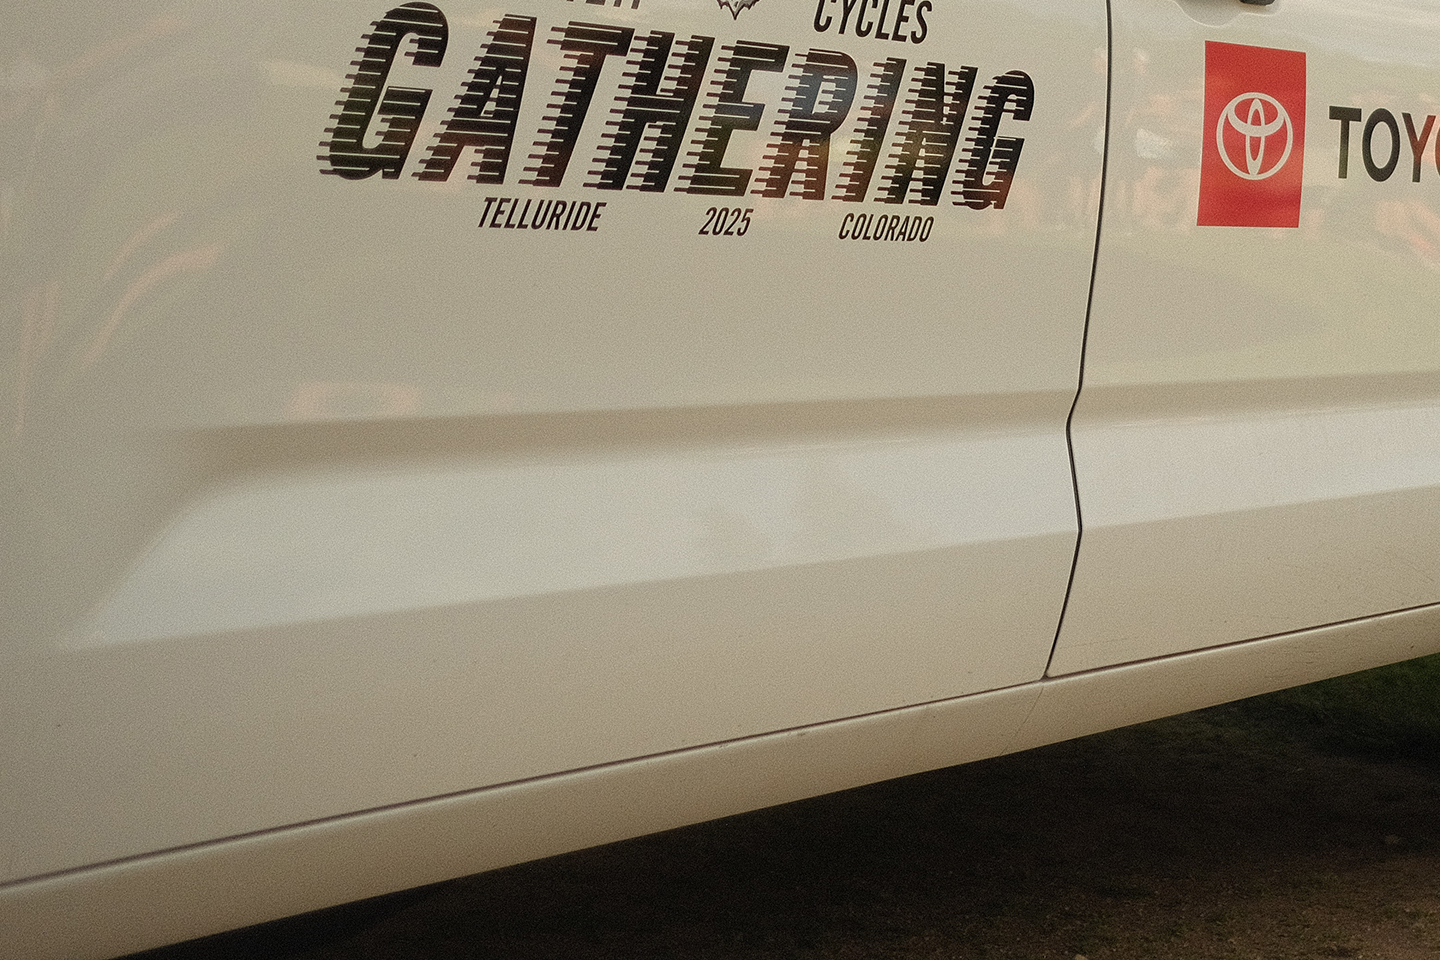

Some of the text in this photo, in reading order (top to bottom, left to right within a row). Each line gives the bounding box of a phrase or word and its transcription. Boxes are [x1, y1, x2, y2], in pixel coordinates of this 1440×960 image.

[316, 2, 1035, 210] GATHERING
[477, 196, 934, 243] TELLURIDE 2025 COLORADO
